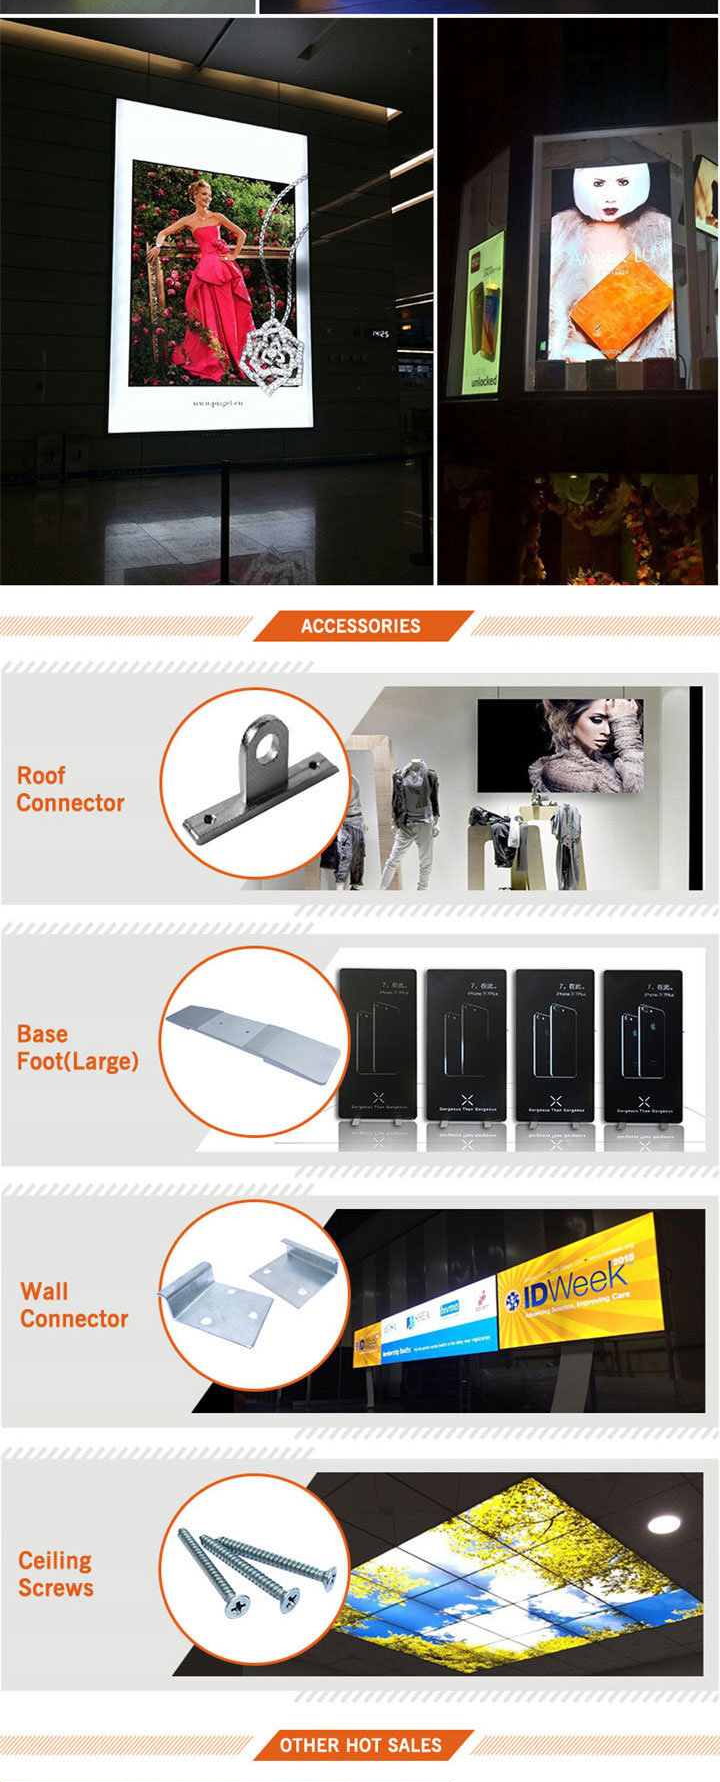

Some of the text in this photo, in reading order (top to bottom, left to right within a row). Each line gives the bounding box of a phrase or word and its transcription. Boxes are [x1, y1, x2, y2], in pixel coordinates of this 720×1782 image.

[471, 375, 497, 388] unlocked
[613, 1252, 635, 1266] 2015
[524, 1260, 628, 1309] IDWeek
